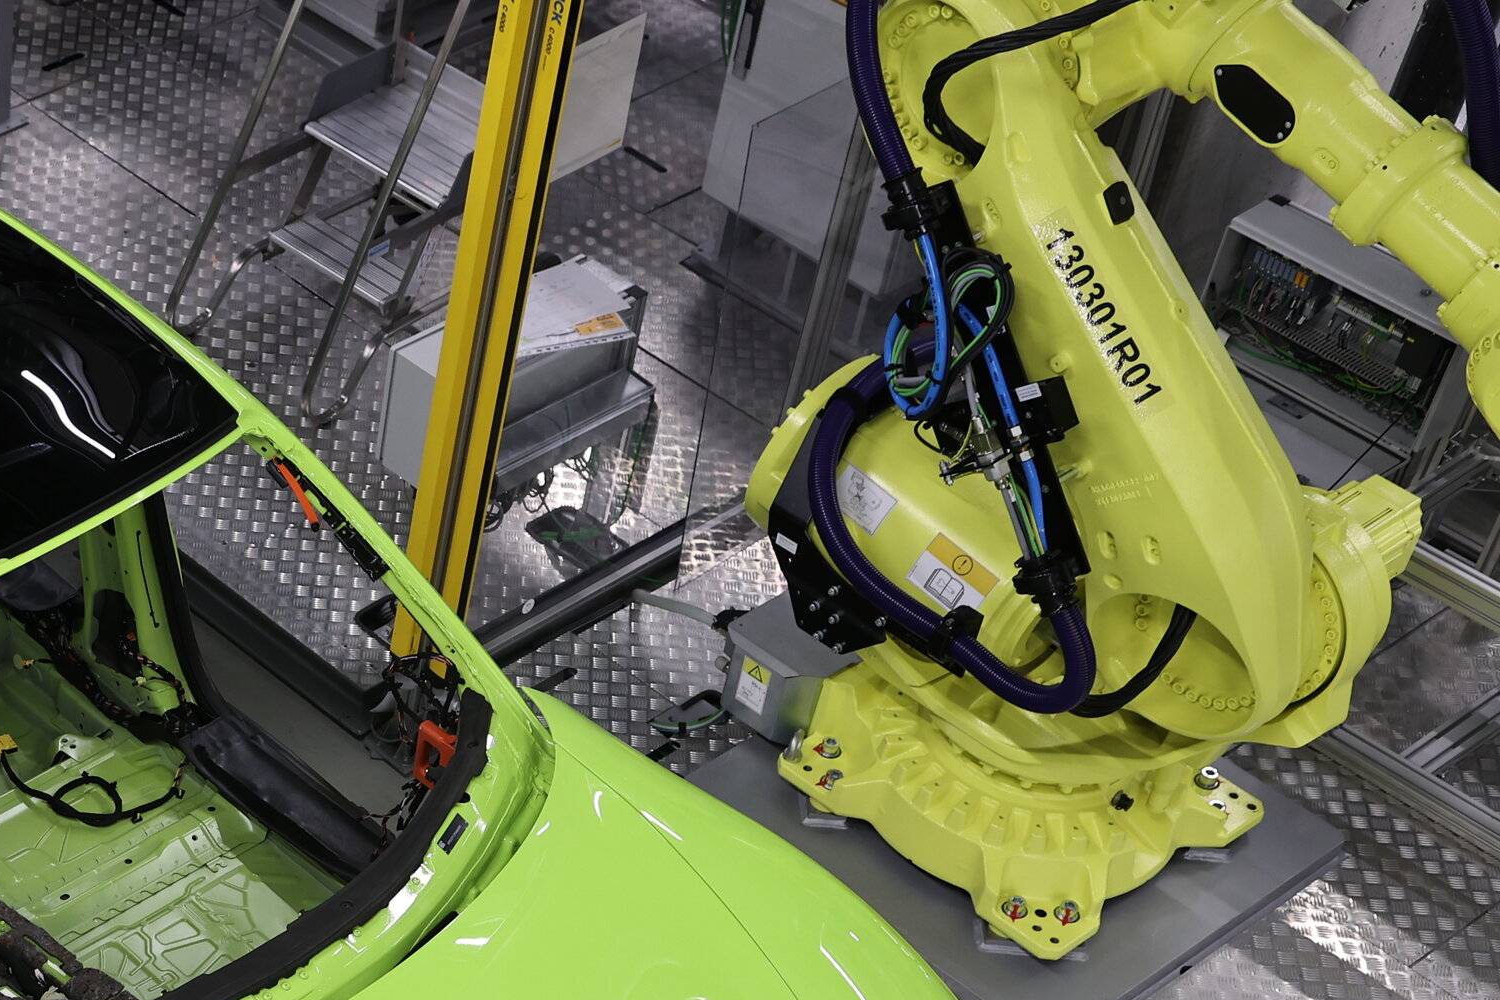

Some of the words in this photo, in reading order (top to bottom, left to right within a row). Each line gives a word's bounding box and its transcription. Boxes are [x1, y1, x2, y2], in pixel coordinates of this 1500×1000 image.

[499, 12, 507, 33] 4000
[545, 34, 554, 55] 4000
[1046, 228, 1162, 405] 130301R01
